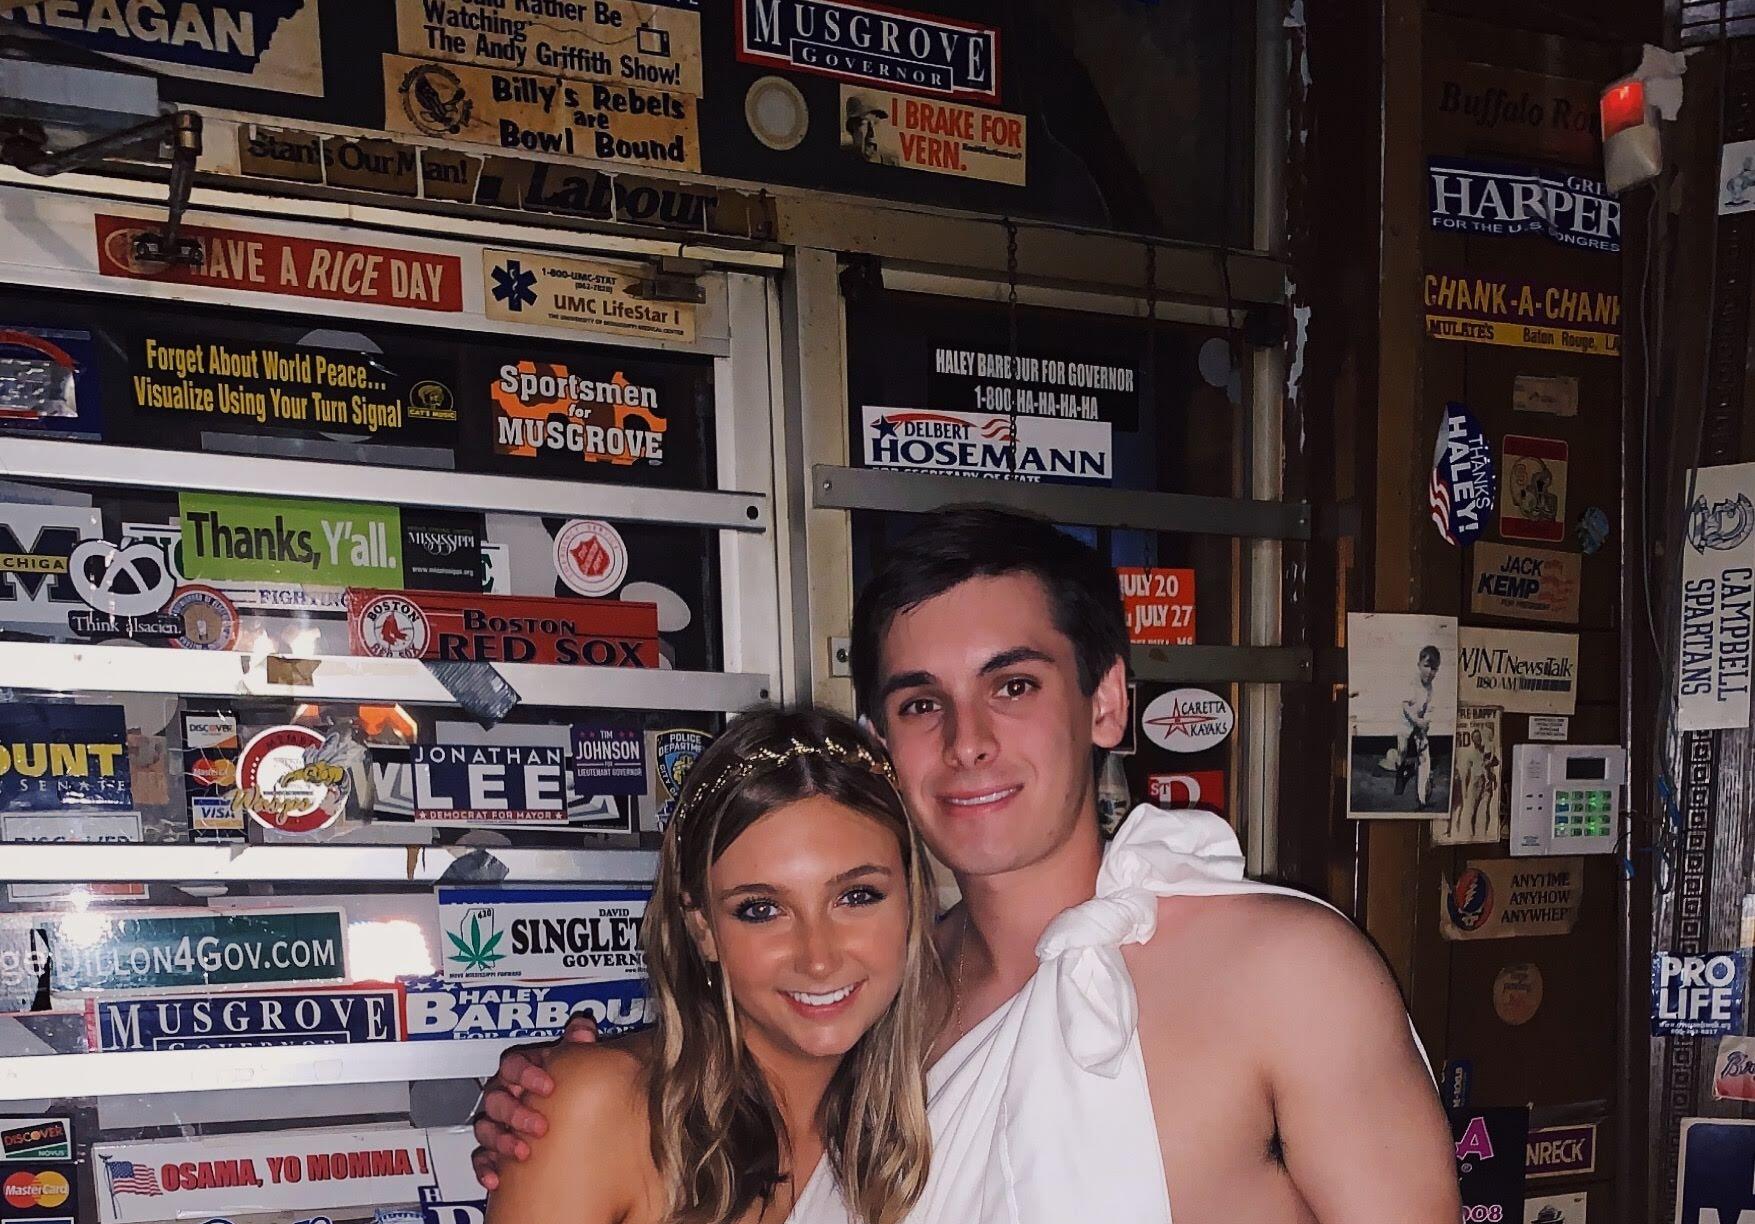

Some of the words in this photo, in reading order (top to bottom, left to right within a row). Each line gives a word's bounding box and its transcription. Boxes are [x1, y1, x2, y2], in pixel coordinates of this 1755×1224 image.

[424, 0, 526, 41] Watching
[594, 0, 622, 26] Be
[424, 25, 466, 53] The
[476, 33, 527, 66] Andy
[536, 42, 611, 75] Griffith
[621, 55, 681, 85] Show!
[754, 0, 985, 82] MUSGROVE
[802, 47, 943, 86] GOVERNOR
[491, 75, 579, 113] Billy's
[593, 83, 684, 120] Rebels
[1440, 81, 1543, 128] Buffalo
[574, 110, 609, 129] are
[891, 98, 898, 126] I
[905, 102, 975, 141] BRAKE
[981, 115, 1022, 149] FOR
[499, 119, 574, 154] Bowl
[595, 130, 684, 163] Bound
[899, 131, 968, 172] VERN.
[339, 142, 389, 173] Our
[523, 163, 718, 224] Labour
[1432, 175, 1620, 238] HARPER
[1433, 217, 1467, 231] FOR
[1473, 221, 1502, 233] THE
[280, 246, 299, 287] A
[307, 248, 384, 297] RICE
[390, 258, 444, 303] DAY
[554, 294, 596, 314] UMC
[603, 300, 668, 323] LifeStar
[1523, 328, 1554, 345] Baton
[146, 339, 203, 378] Forget
[209, 345, 258, 378] About
[263, 351, 310, 384] World
[936, 348, 975, 376] HALEY
[1041, 360, 1066, 384] FOR
[1068, 363, 1134, 393] GOVERNOR
[500, 364, 658, 409] Sportsmen
[134, 376, 213, 412] Visualize
[218, 384, 266, 423] Using
[269, 388, 307, 418] Your
[312, 393, 347, 423] Turn
[352, 395, 402, 432] Signal
[568, 403, 592, 419] for
[498, 415, 663, 459] MUSGROVE
[905, 420, 971, 441] DELBERT
[871, 438, 1105, 476] HOSEMANN
[1468, 433, 1490, 509] THANKS
[1447, 415, 1479, 533] HALEY!
[187, 511, 321, 570] Thanks,
[408, 531, 475, 556] MISSISSIPPI
[3, 557, 65, 571] CHIGA
[1500, 555, 1544, 577] JACK
[1155, 575, 1178, 597] 20
[1478, 573, 1540, 599] KEMP
[72, 615, 119, 633] Think
[368, 601, 420, 622] BOSTON
[1135, 605, 1169, 634] JULY
[1171, 606, 1193, 627] 27
[1681, 579, 1715, 696] SPARTANS
[1717, 567, 1753, 702] CAMPBELL
[438, 633, 537, 663] RED
[556, 638, 650, 669] SOX
[1181, 701, 1226, 715] CARETTA
[600, 731, 612, 739] TIM
[670, 734, 701, 744] POLICE
[1191, 722, 1227, 736] KAYAKS
[415, 748, 561, 765] JONATHAN
[576, 741, 640, 760] JOHNSON
[20, 780, 125, 793] SENATE
[416, 764, 561, 810] LEE
[577, 768, 611, 777] LIEUTENANT
[201, 807, 235, 818] VISA
[430, 812, 489, 820] DEMOCRAT
[492, 811, 512, 820] FOR
[516, 811, 551, 819] MAYOR
[1511, 873, 1570, 887] ANYTIME
[599, 908, 629, 917] DAVID
[1510, 890, 1570, 905] ANYHOW
[511, 917, 644, 954] SINGLET
[562, 953, 648, 968] GOVERN
[1660, 955, 1736, 987] PRO
[459, 987, 551, 1005] HALEY
[1659, 987, 1731, 1020] LIFE
[108, 997, 388, 1050] MUSGROVE
[406, 991, 654, 1035] BARBOU
[4, 1126, 63, 1146] DISCOVER
[161, 1159, 263, 1192] OSAMA,
[266, 1155, 301, 1184] YO
[5, 1184, 70, 1196] MasterCard
